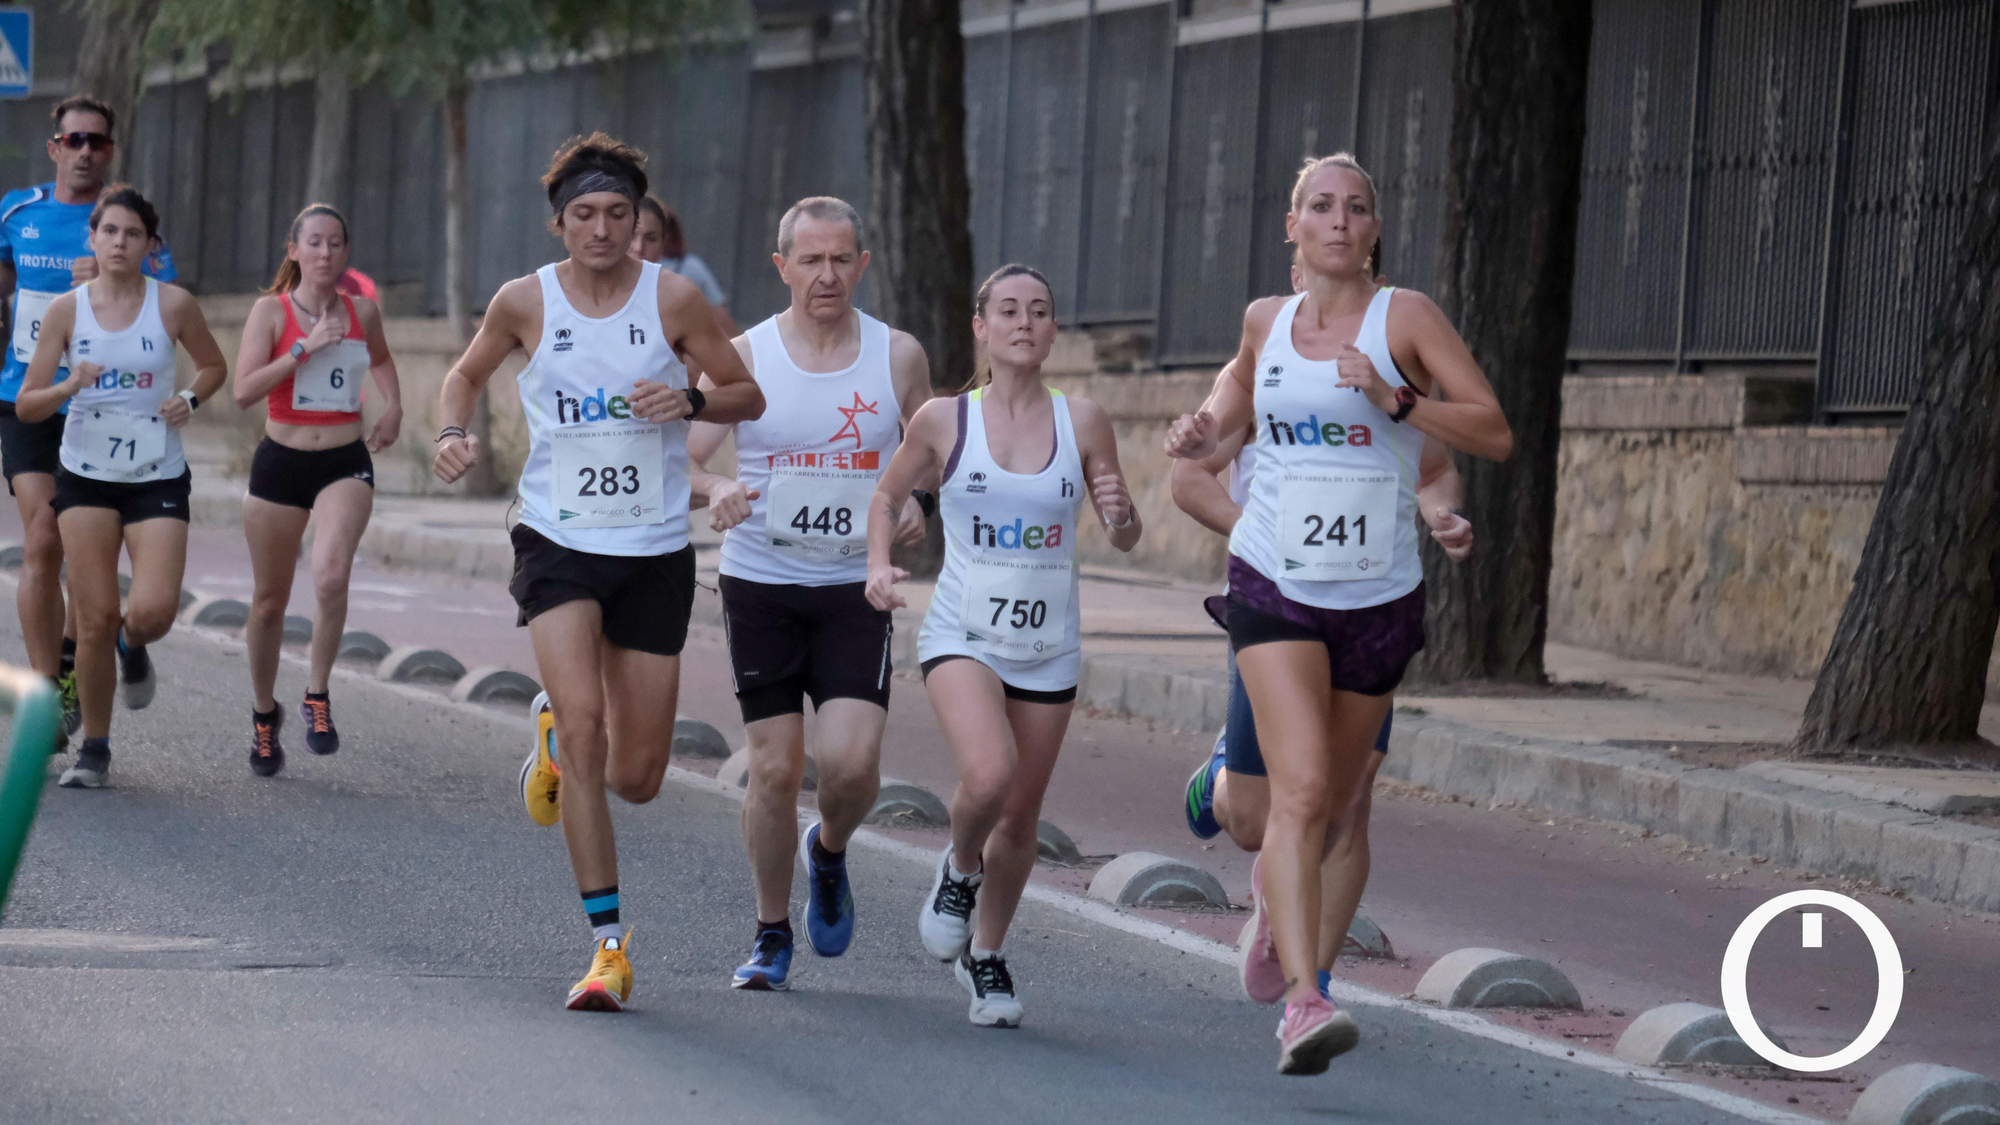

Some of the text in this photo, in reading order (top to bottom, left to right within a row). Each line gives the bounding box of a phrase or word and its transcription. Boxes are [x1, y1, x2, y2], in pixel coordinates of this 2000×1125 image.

[19, 254, 75, 271] TROTASIE
[95, 368, 153, 390] dea
[330, 368, 345, 390] 6
[555, 387, 632, 424] inde
[569, 431, 601, 439] CARRERA
[623, 428, 646, 436] MUJER
[1267, 413, 1372, 447] indea
[108, 437, 137, 461] 71
[578, 465, 641, 497] 283
[789, 470, 820, 478] CARRERA
[1300, 475, 1332, 483] CARRERA
[790, 505, 852, 537] 448
[973, 515, 1063, 550] indea
[1303, 514, 1367, 547] 241
[987, 560, 1019, 569] CARRERA
[989, 597, 1047, 629] 750
